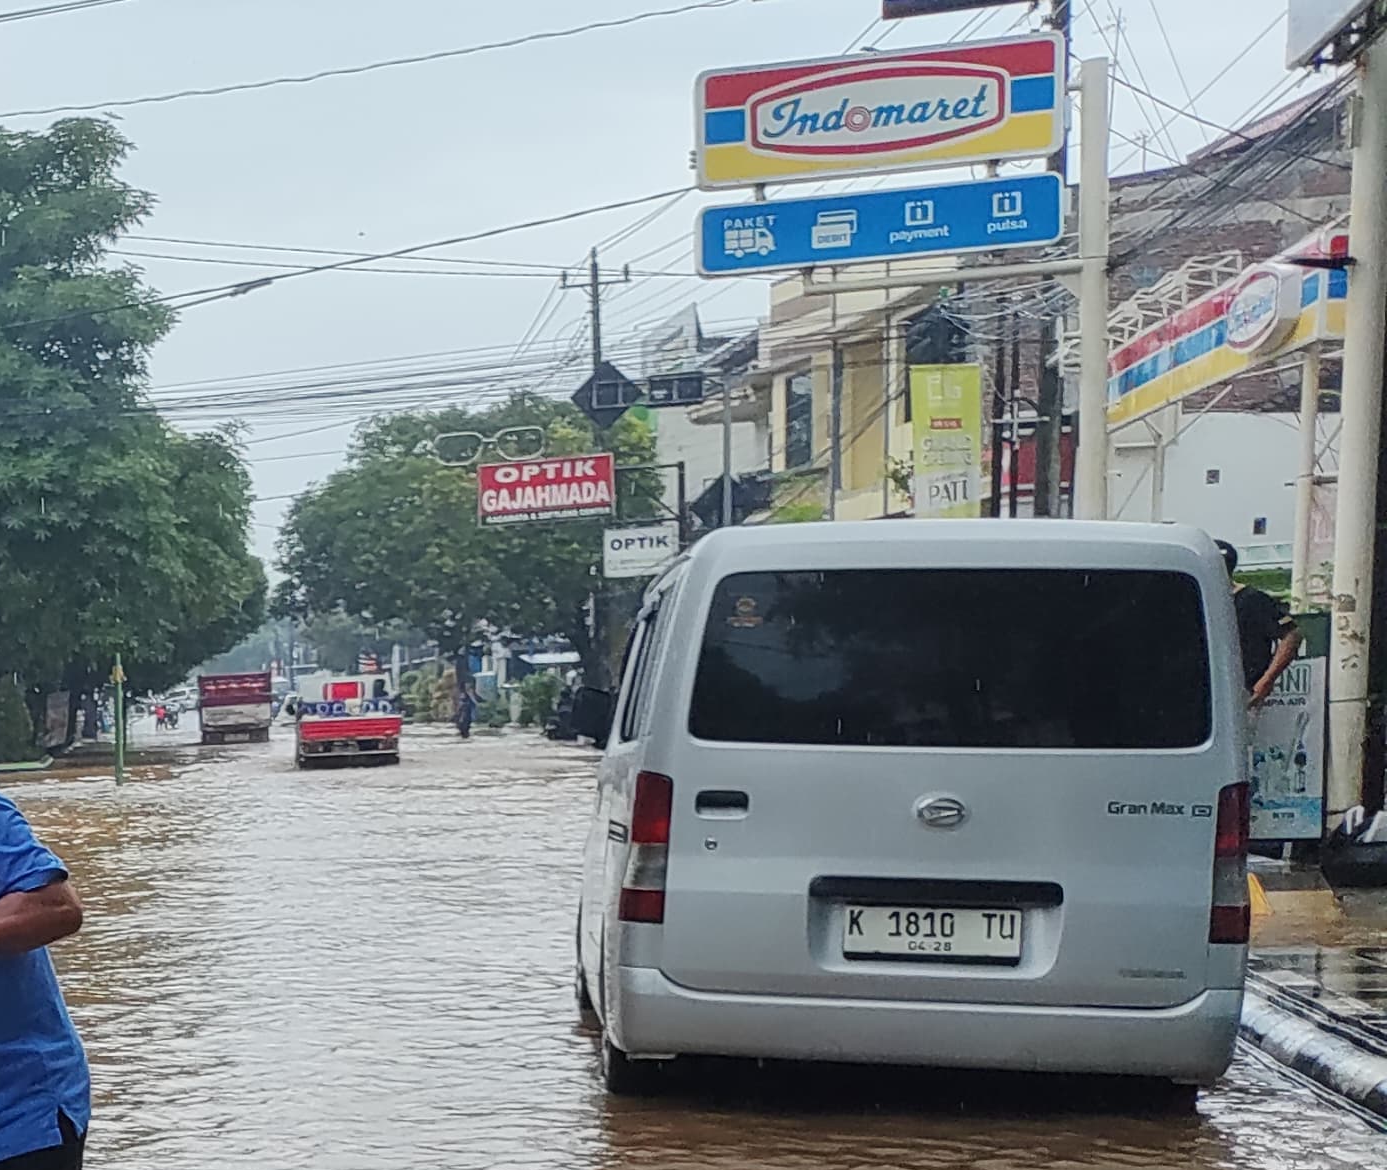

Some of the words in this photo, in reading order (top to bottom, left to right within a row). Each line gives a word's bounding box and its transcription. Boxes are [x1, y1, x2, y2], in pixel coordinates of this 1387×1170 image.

[762, 84, 990, 139] Indomaret
[723, 215, 778, 231] PAKET
[986, 218, 1029, 234] pulsa
[817, 233, 849, 245] DEBIT
[888, 224, 950, 244] payment
[494, 459, 597, 484] OPTIK
[481, 480, 611, 513] GAJAHMADA
[610, 535, 669, 551] OPTIK
[1107, 801, 1148, 816] Gran
[1150, 802, 1186, 816] Max
[848, 909, 864, 936] K
[887, 911, 955, 938] 1810
[981, 913, 1015, 940] TU
